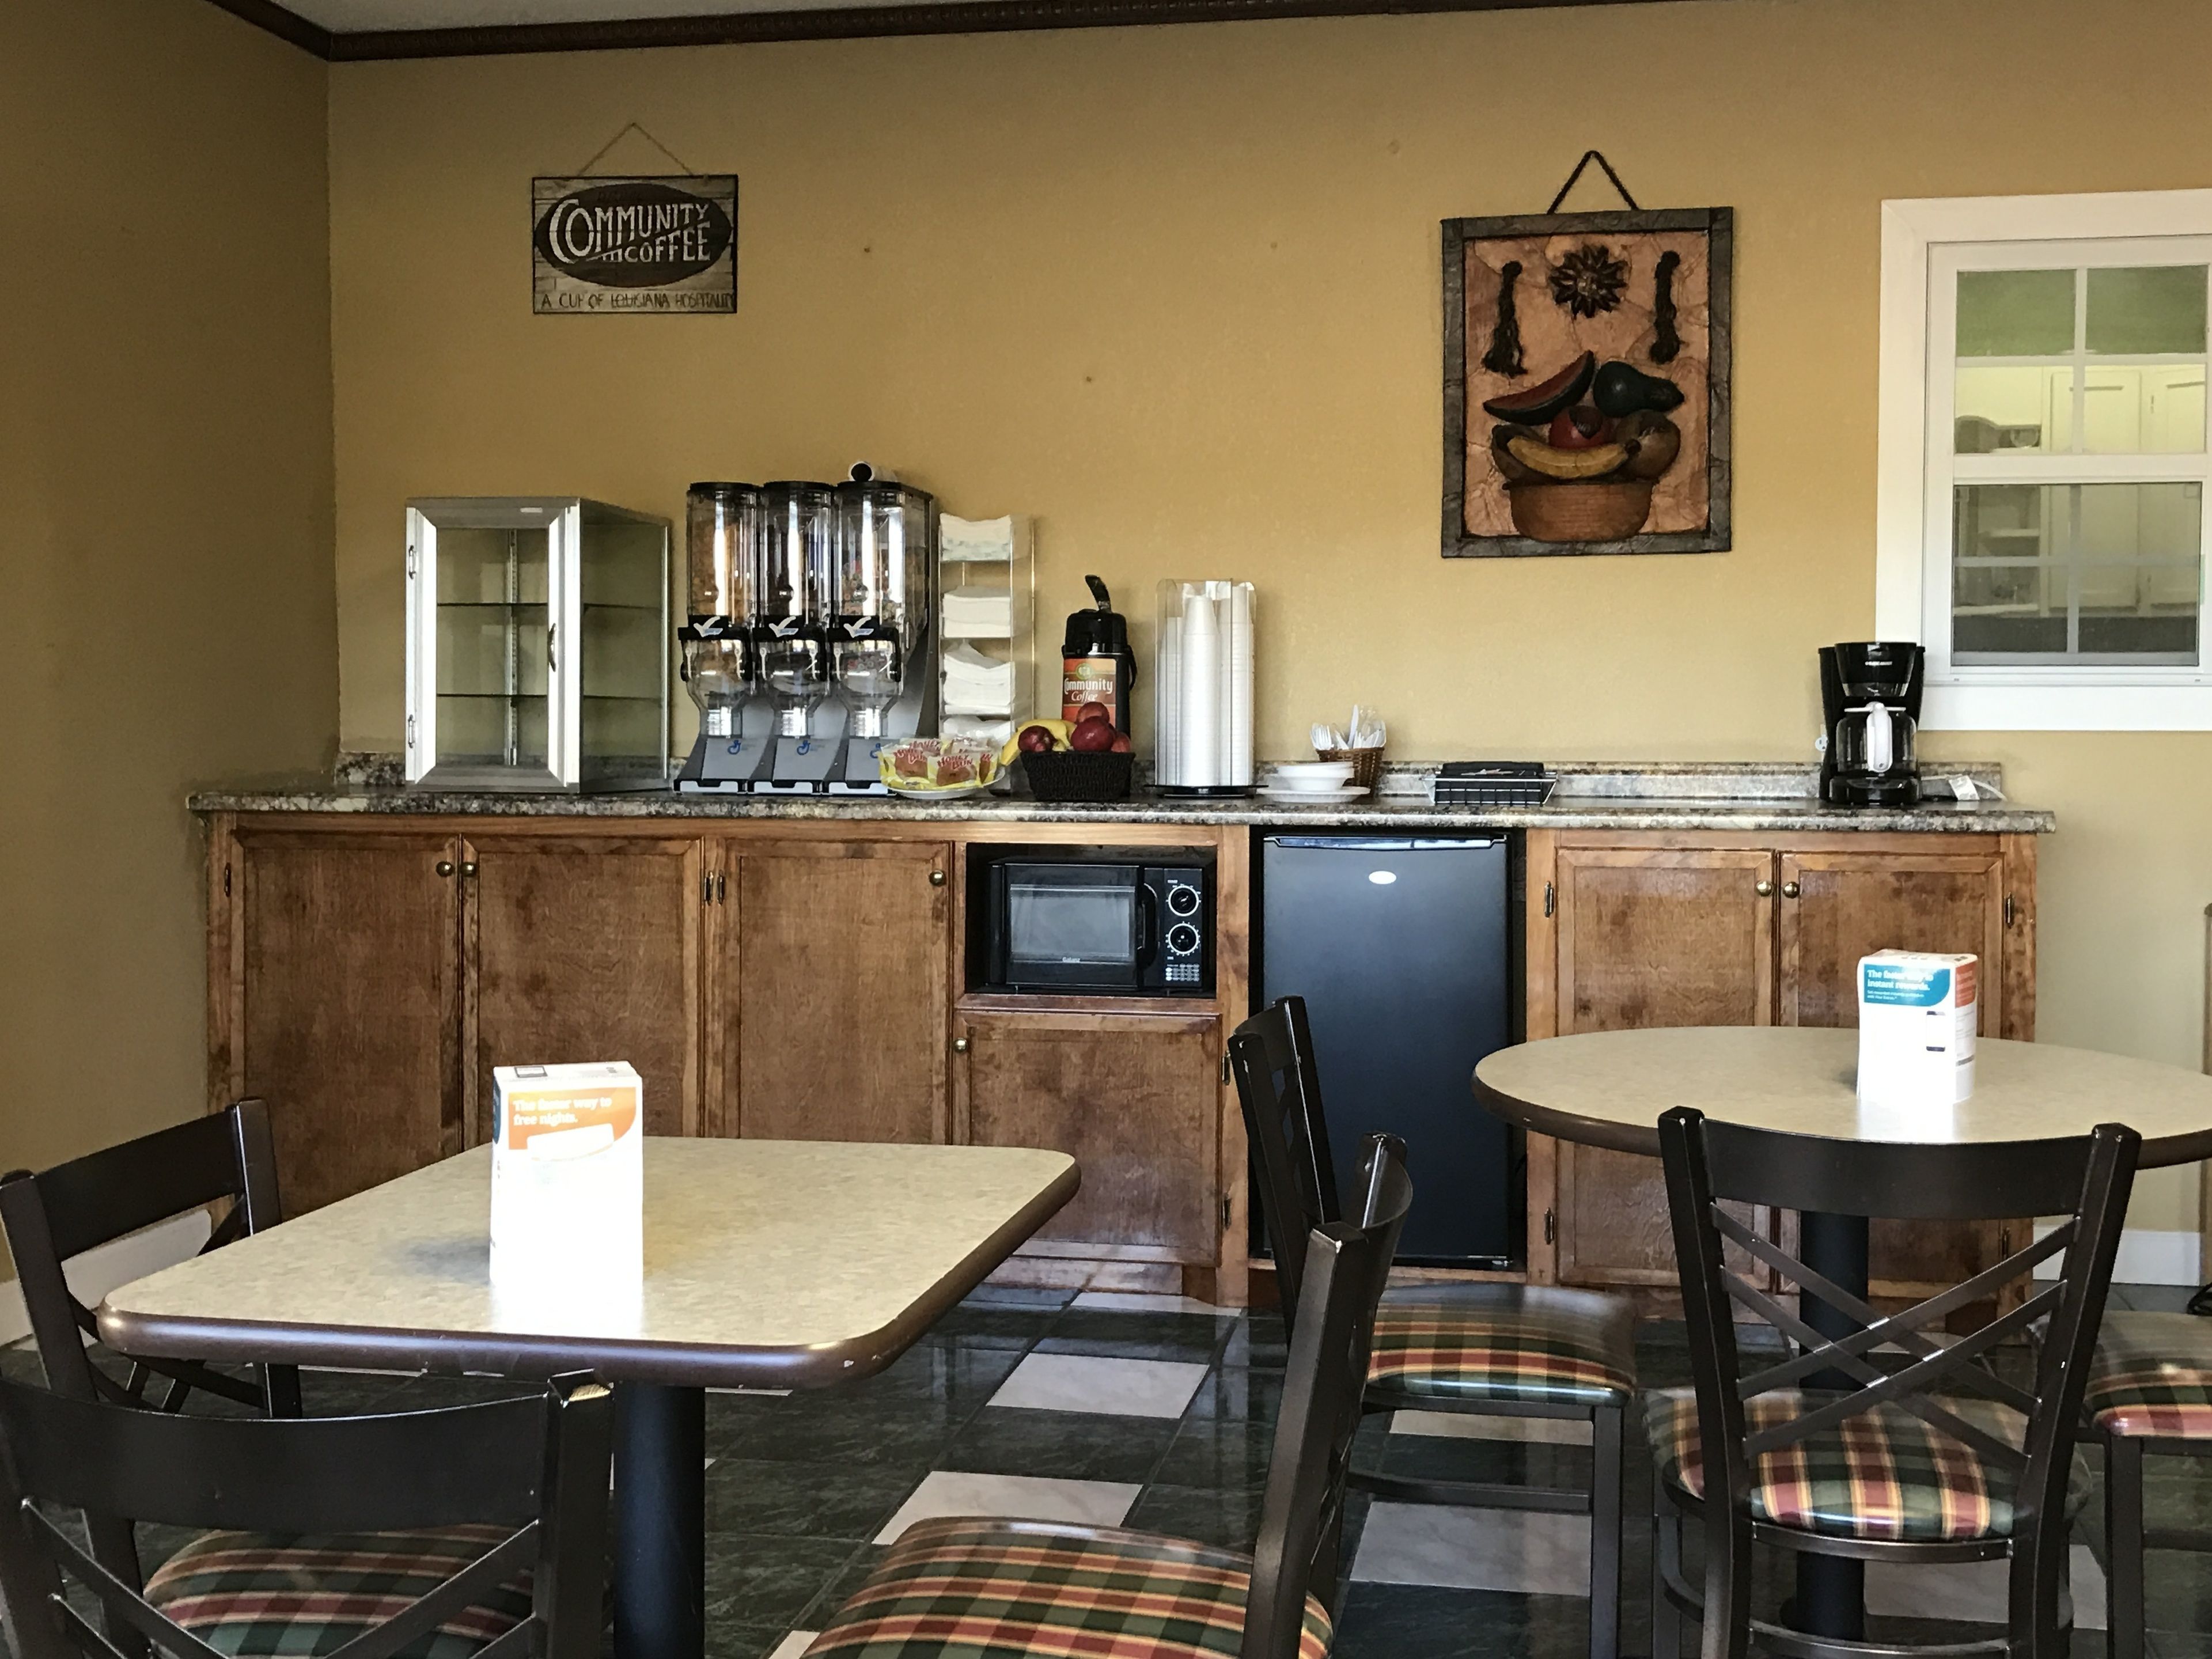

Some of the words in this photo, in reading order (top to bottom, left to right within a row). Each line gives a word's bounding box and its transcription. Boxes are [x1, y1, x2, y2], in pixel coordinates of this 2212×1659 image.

[549, 199, 710, 264] COMMUNITY
[624, 221, 711, 263] COFFEE
[541, 294, 551, 308] A
[559, 293, 584, 308] CUP
[588, 293, 604, 309] OF
[1064, 677, 1113, 695] Community
[1071, 691, 1098, 703] Coffee
[1867, 969, 1882, 978] The
[573, 1098, 599, 1111] way
[600, 1097, 612, 1108] to
[513, 1113, 537, 1126] free
